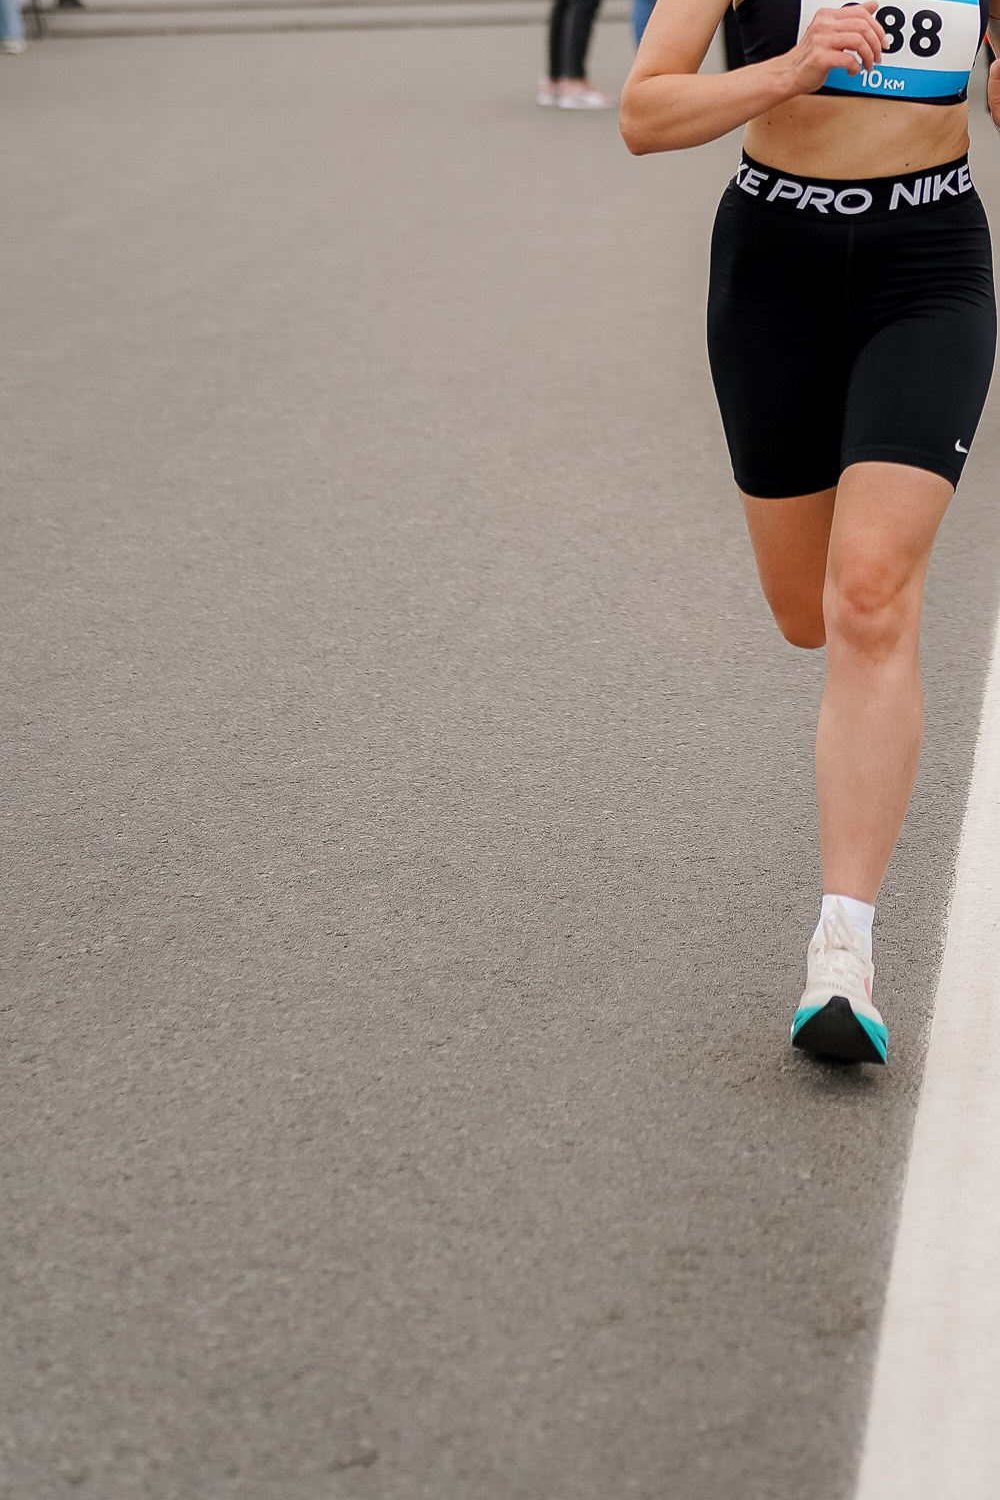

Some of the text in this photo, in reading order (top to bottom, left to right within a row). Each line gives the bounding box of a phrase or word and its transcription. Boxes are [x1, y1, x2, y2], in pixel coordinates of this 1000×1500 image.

[841, 2, 943, 58] 88
[736, 162, 972, 216] KE PRO NIKE
